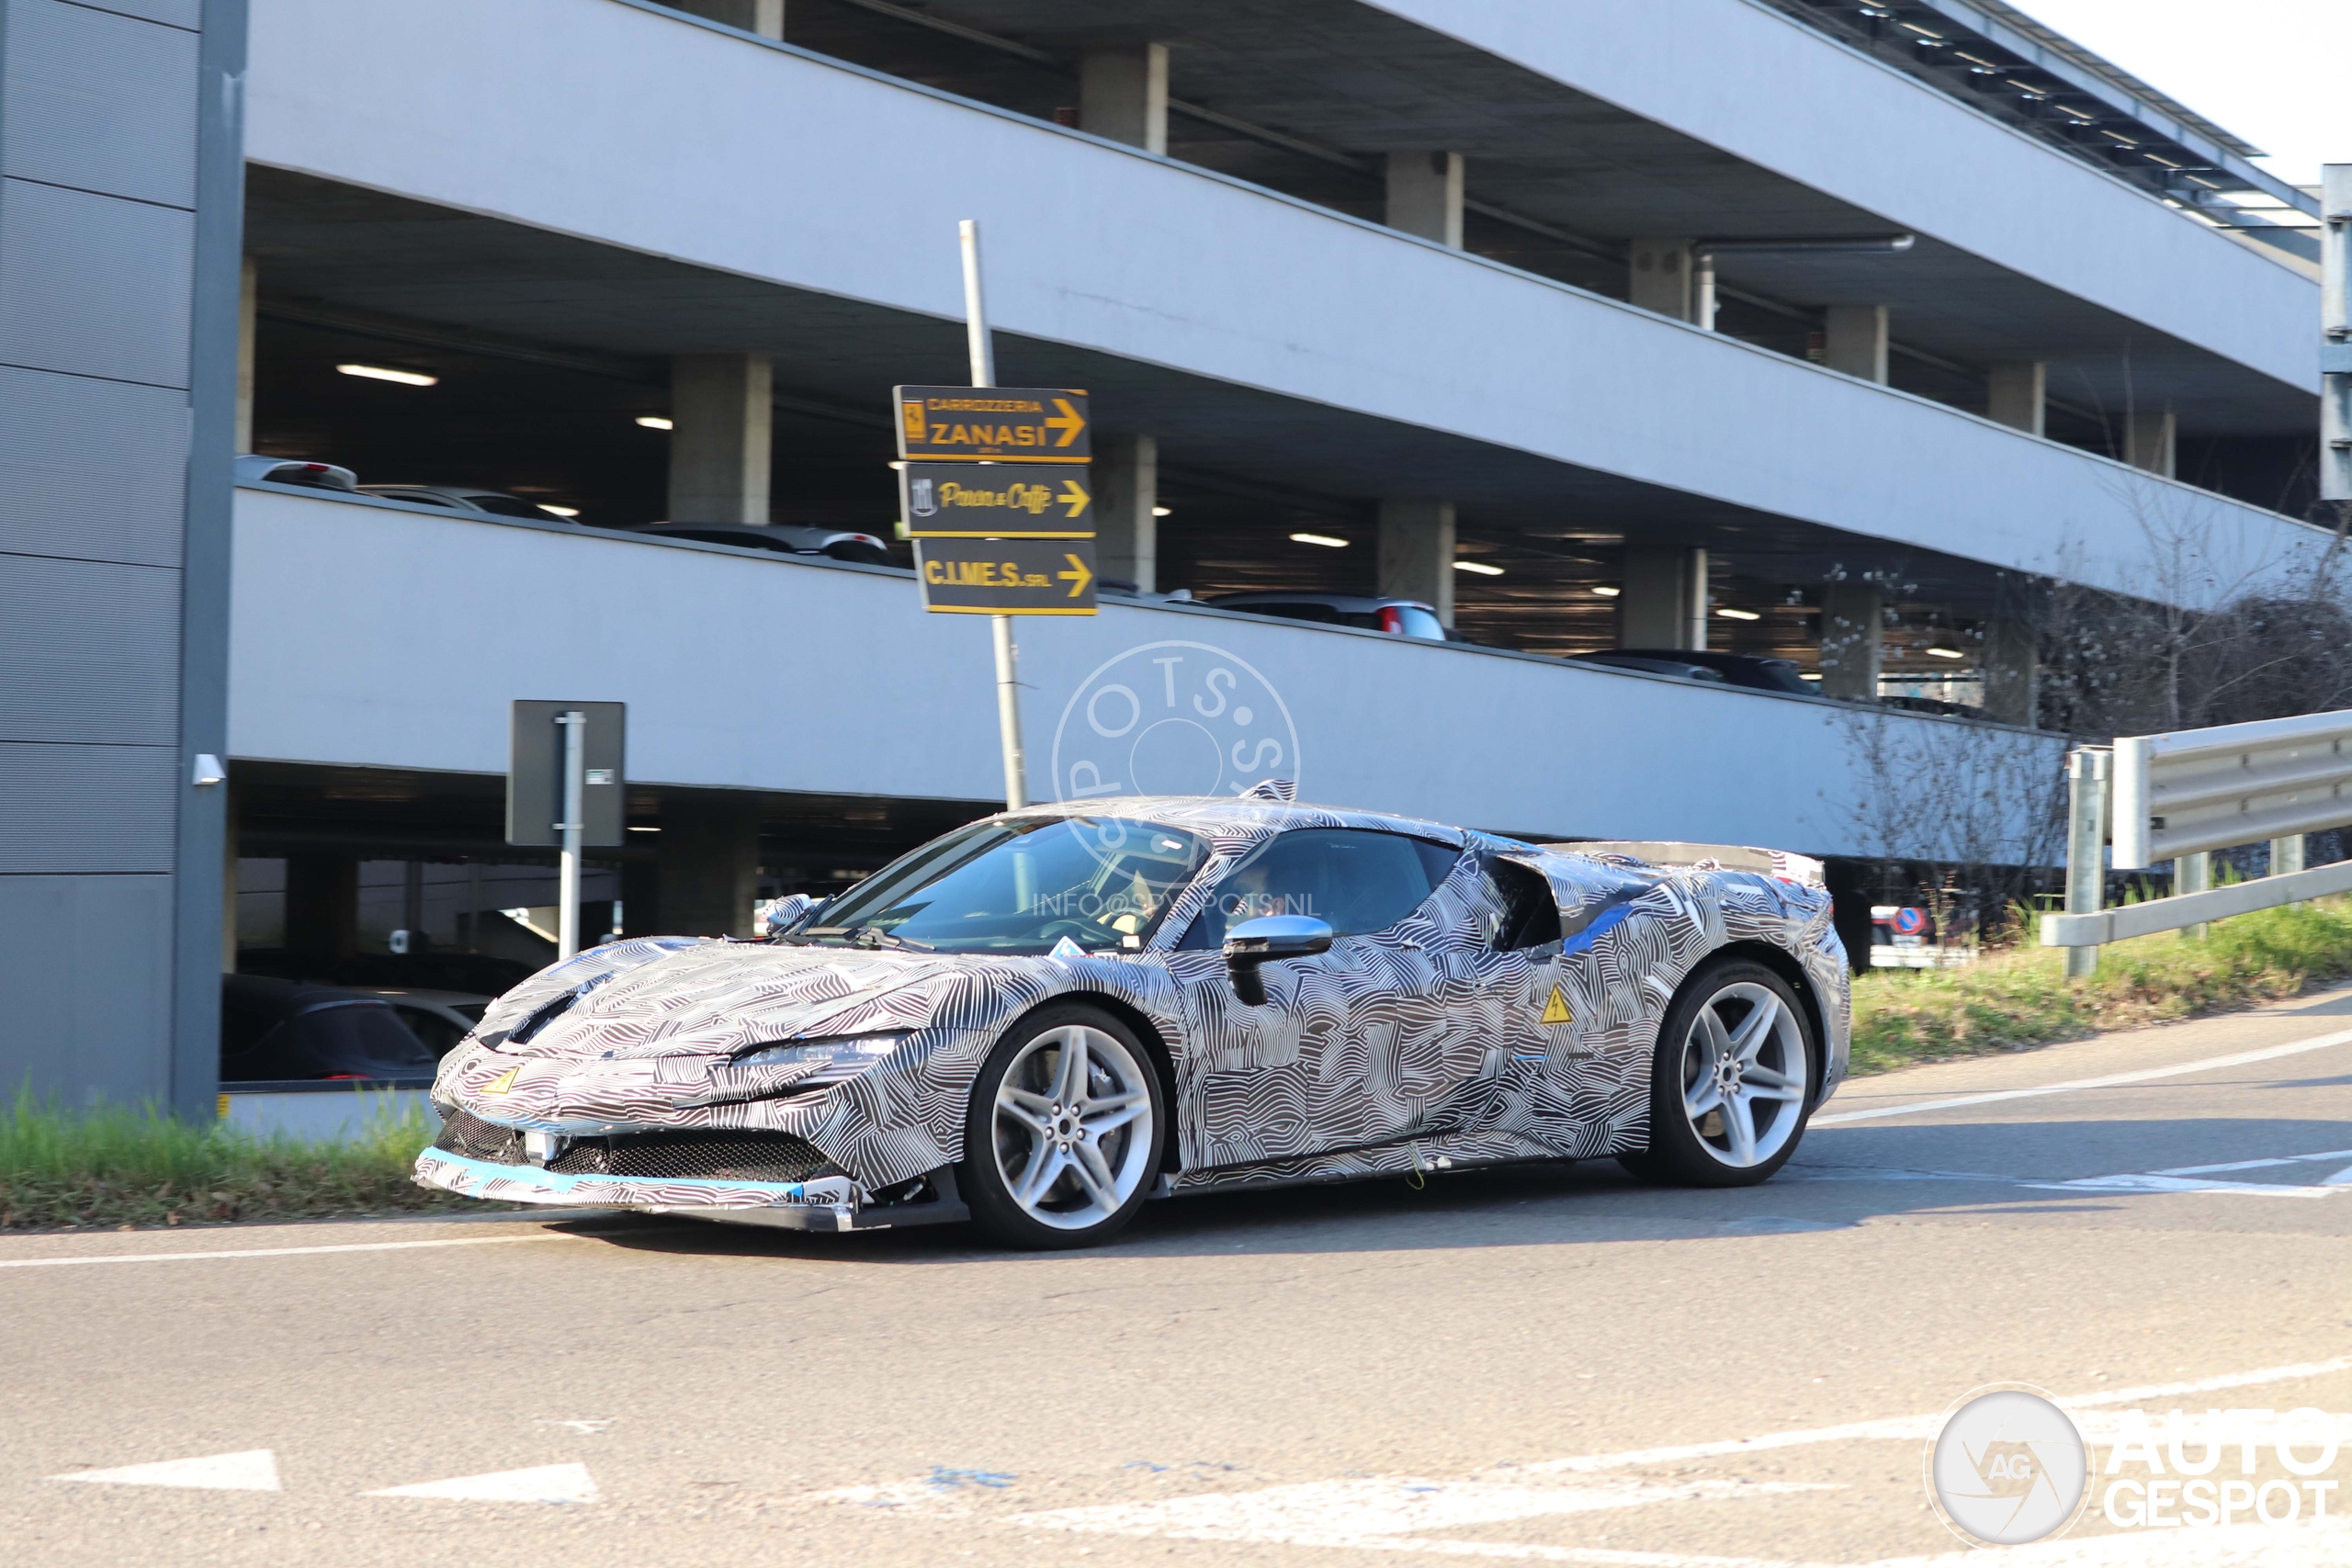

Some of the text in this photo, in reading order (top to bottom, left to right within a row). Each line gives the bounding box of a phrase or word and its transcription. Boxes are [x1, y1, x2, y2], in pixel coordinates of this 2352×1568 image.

[926, 398, 1044, 412] CARROZZERIA
[930, 423, 1046, 446] ZANASI
[995, 492, 1007, 505] &
